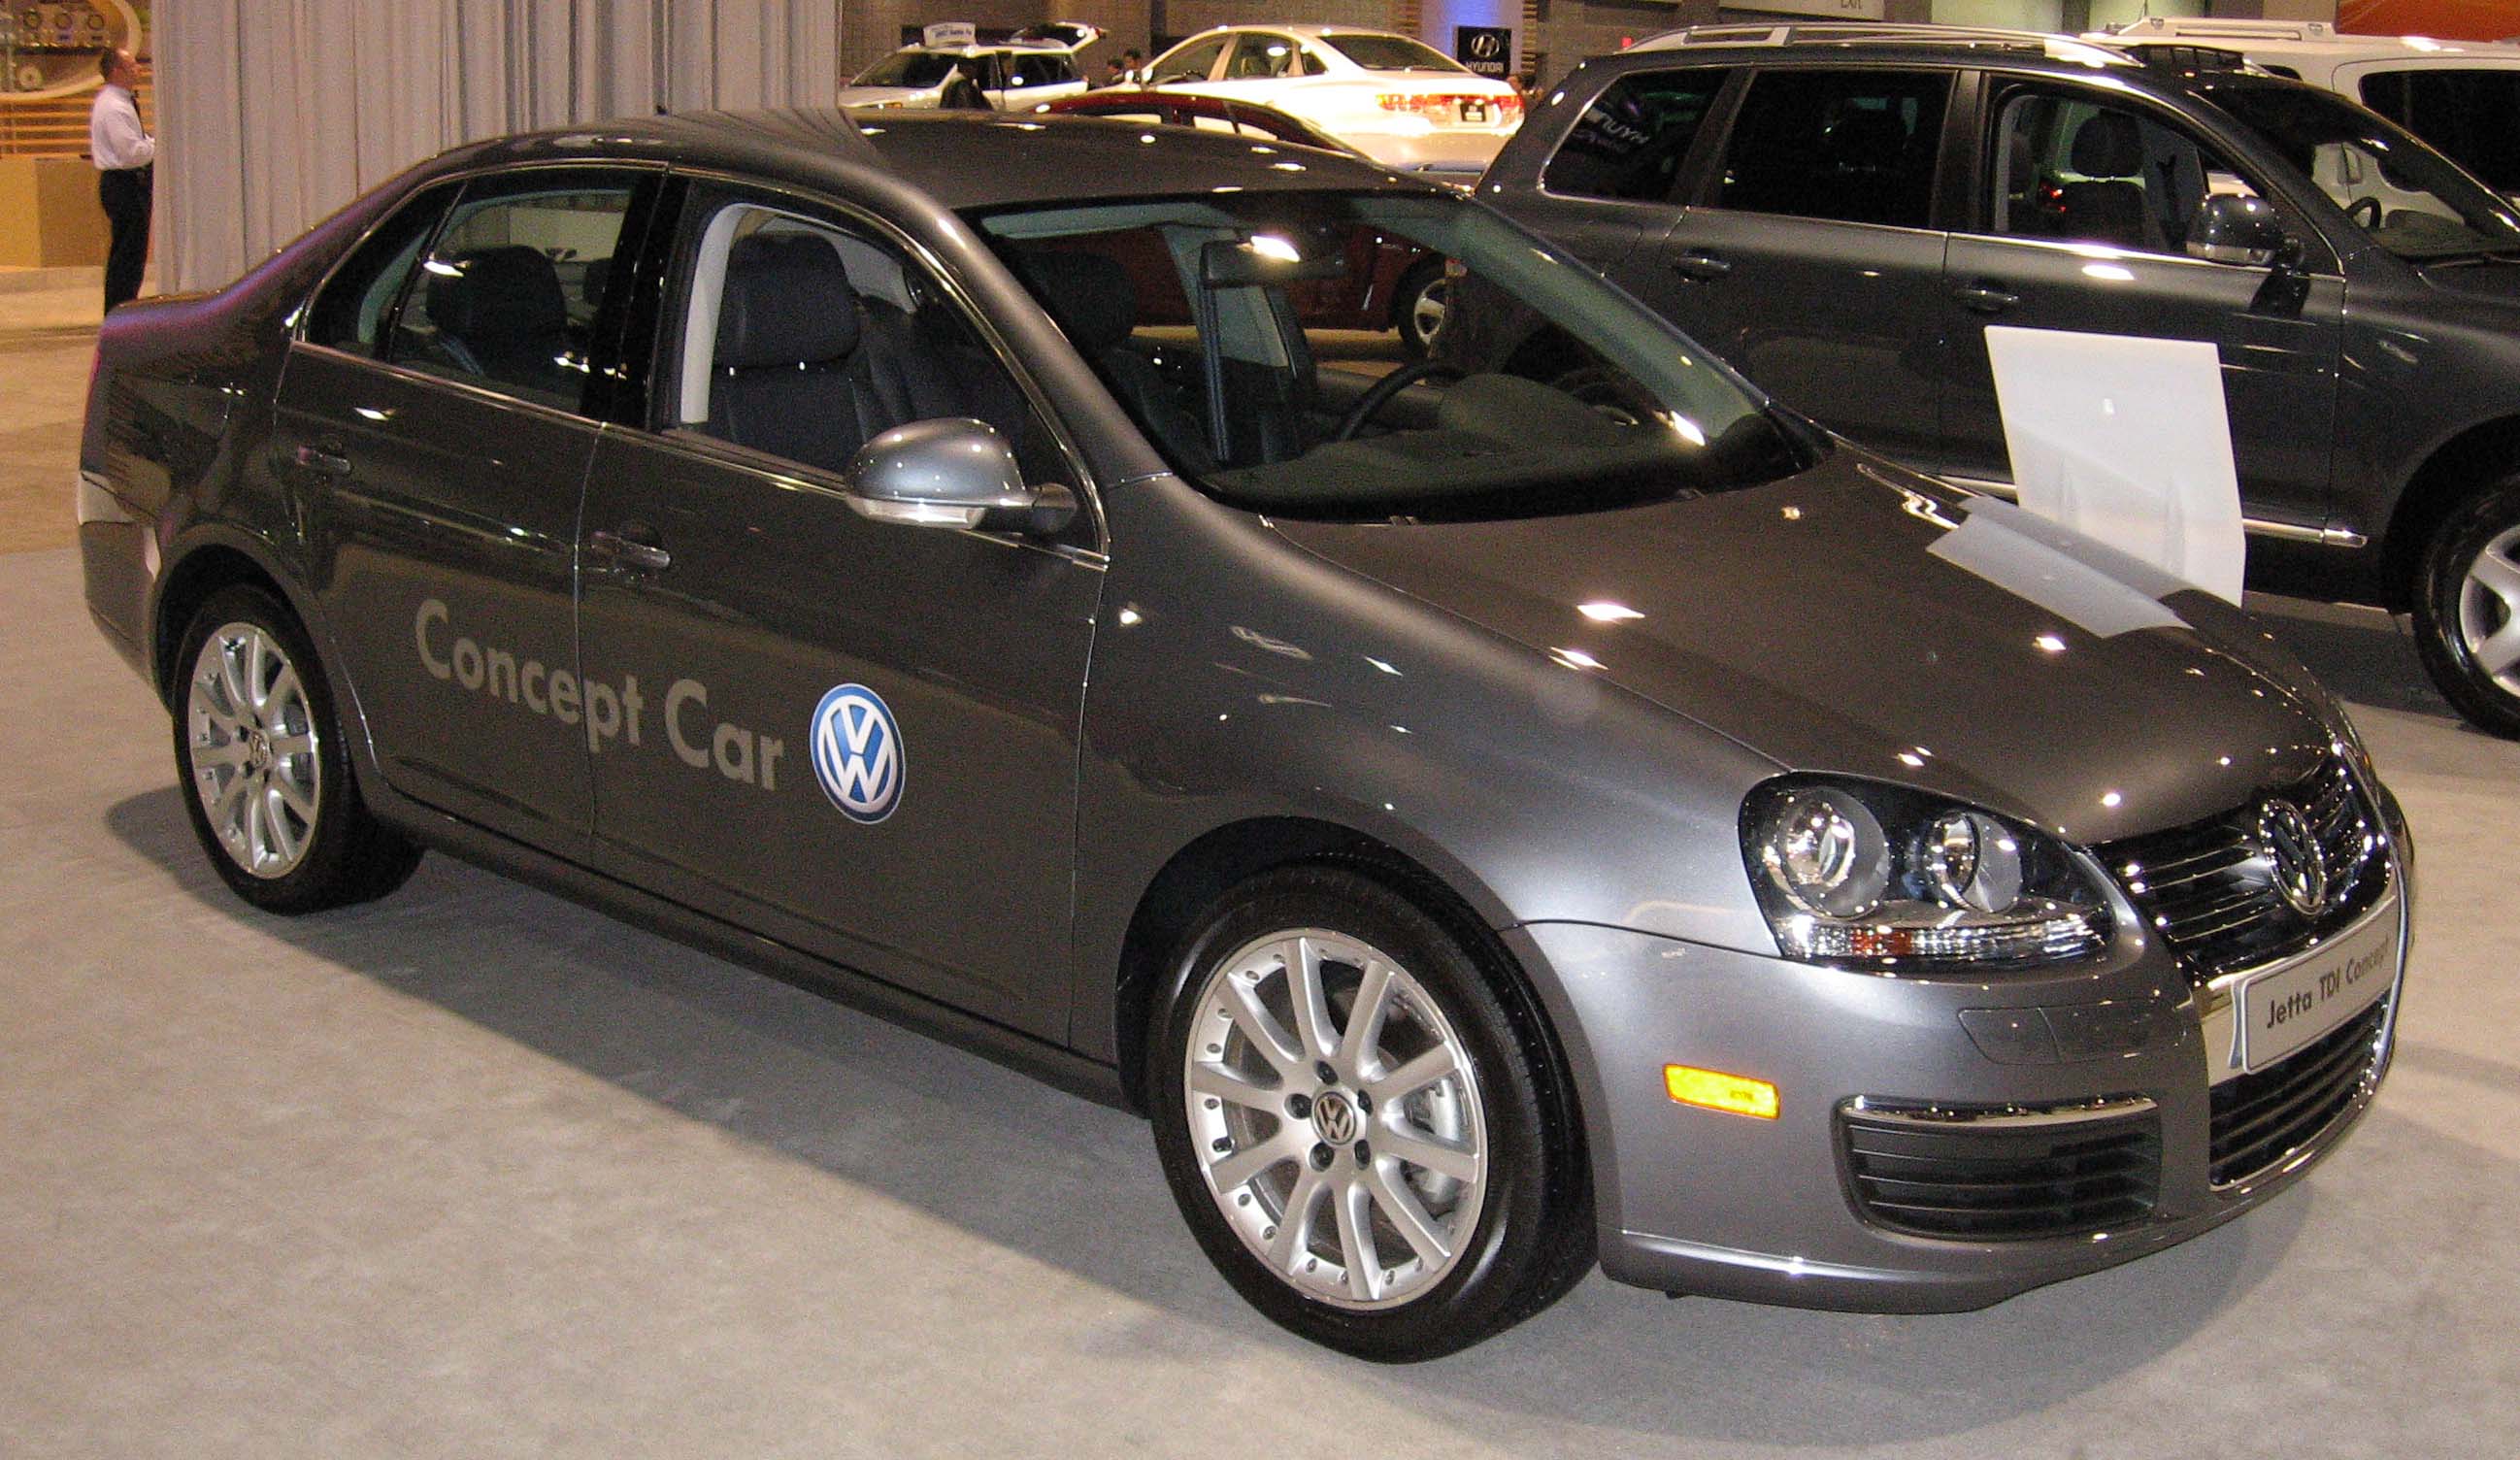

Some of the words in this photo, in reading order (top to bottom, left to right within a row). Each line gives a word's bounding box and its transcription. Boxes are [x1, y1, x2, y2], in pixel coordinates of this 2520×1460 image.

[1466, 61, 1504, 74] HYUNDAI
[415, 599, 644, 754] Concept
[665, 680, 784, 791] Car
[2267, 991, 2312, 1029] Jetta
[2319, 964, 2340, 1002] TDI
